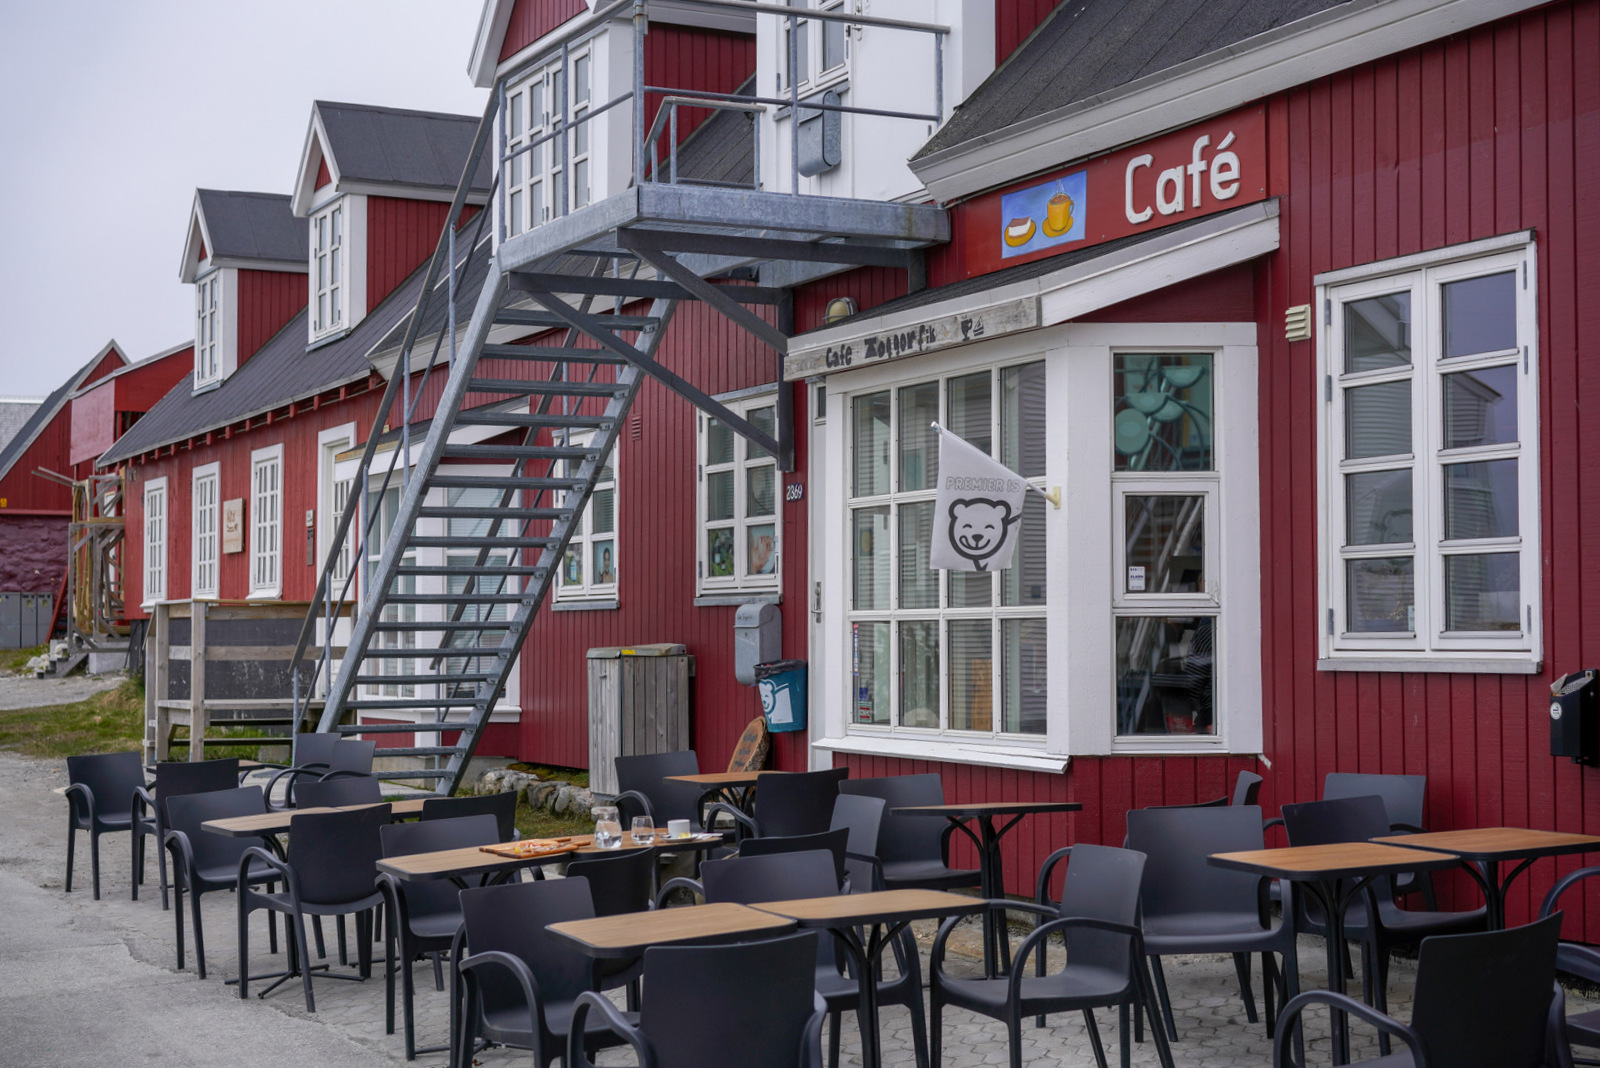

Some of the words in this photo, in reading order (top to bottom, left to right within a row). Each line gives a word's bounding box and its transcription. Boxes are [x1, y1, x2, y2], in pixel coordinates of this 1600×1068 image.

[1125, 130, 1241, 225] Café
[786, 484, 803, 500] 2369
[945, 476, 1005, 492] PREMIER
[1007, 479, 1021, 492] IS
